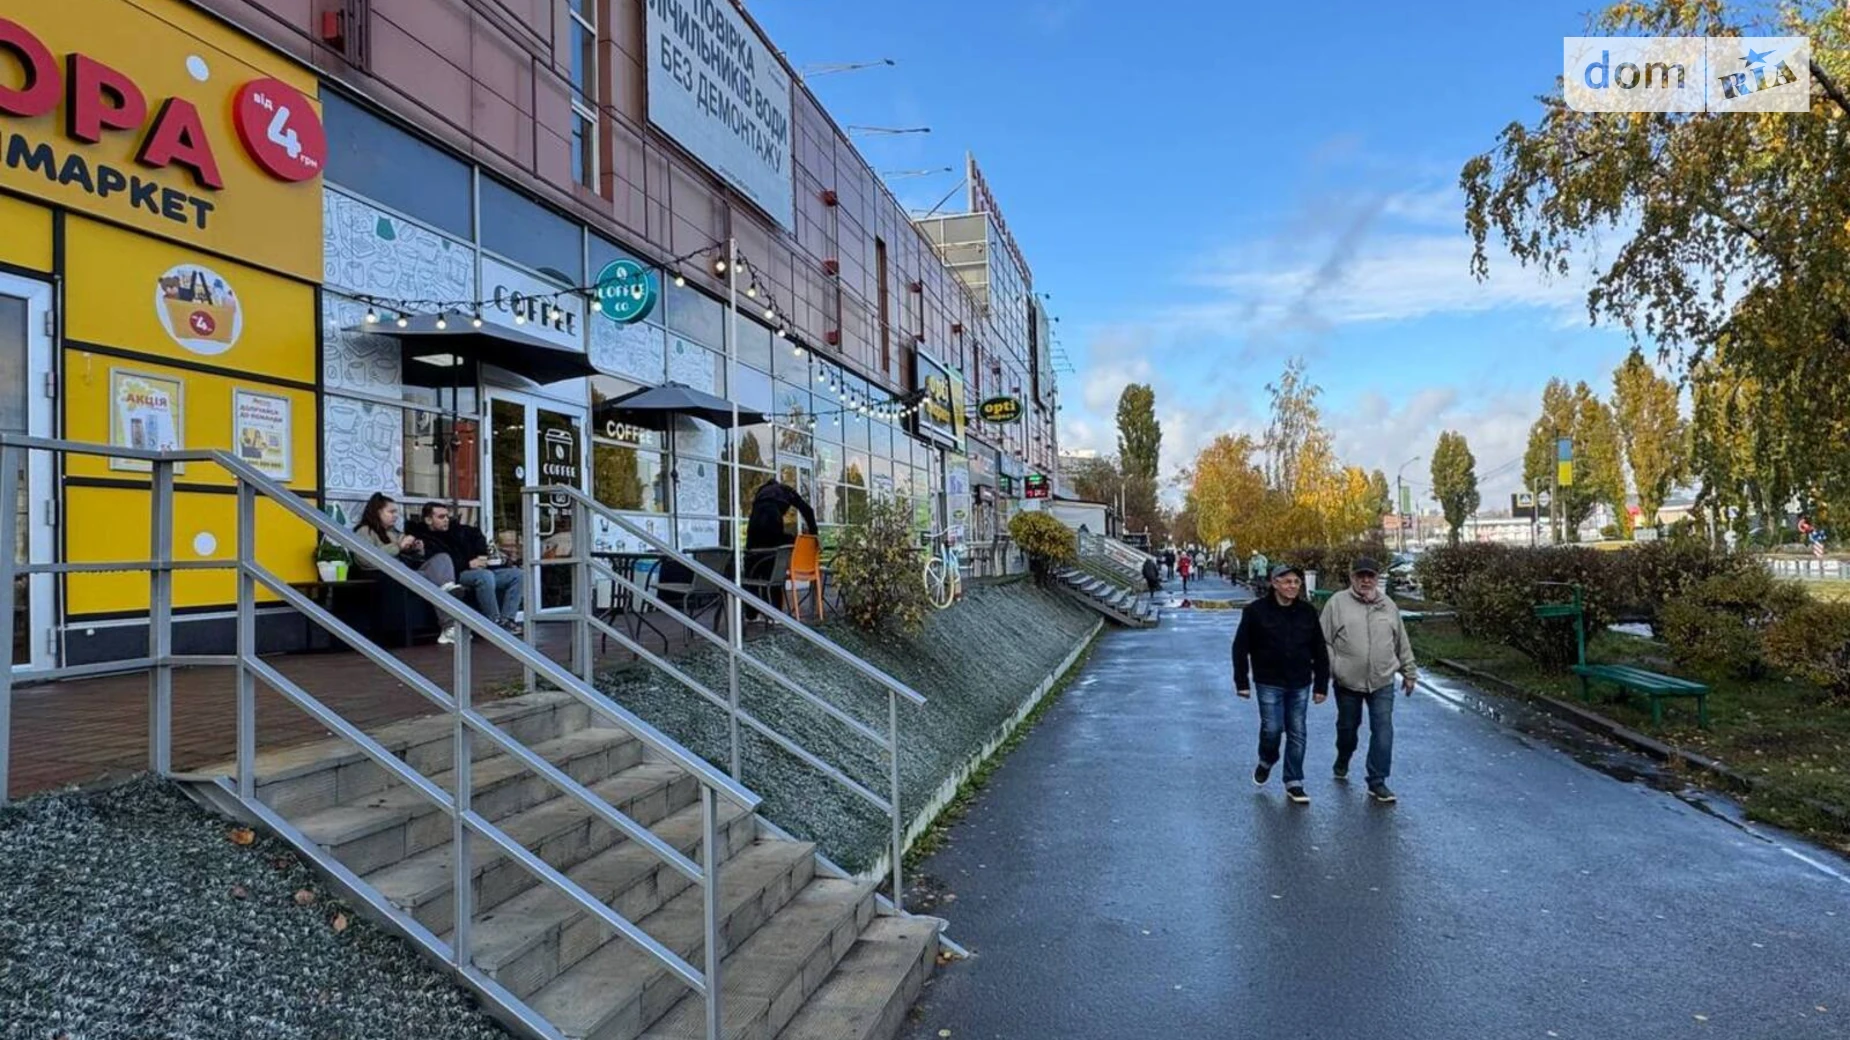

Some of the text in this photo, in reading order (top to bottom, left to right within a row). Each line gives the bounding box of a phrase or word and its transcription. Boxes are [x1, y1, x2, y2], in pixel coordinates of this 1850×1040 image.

[660, 34, 782, 173] БЕЗ ДЕМОНТАЖУ
[754, 88, 788, 146] ВОДИ
[267, 106, 302, 159] 4
[0, 131, 216, 230] МАРКЕТ
[126, 393, 167, 408] АКЦІЯ
[984, 400, 1016, 414] opti
[606, 420, 654, 444] COFFEE
[543, 463, 576, 478] COFFEE
